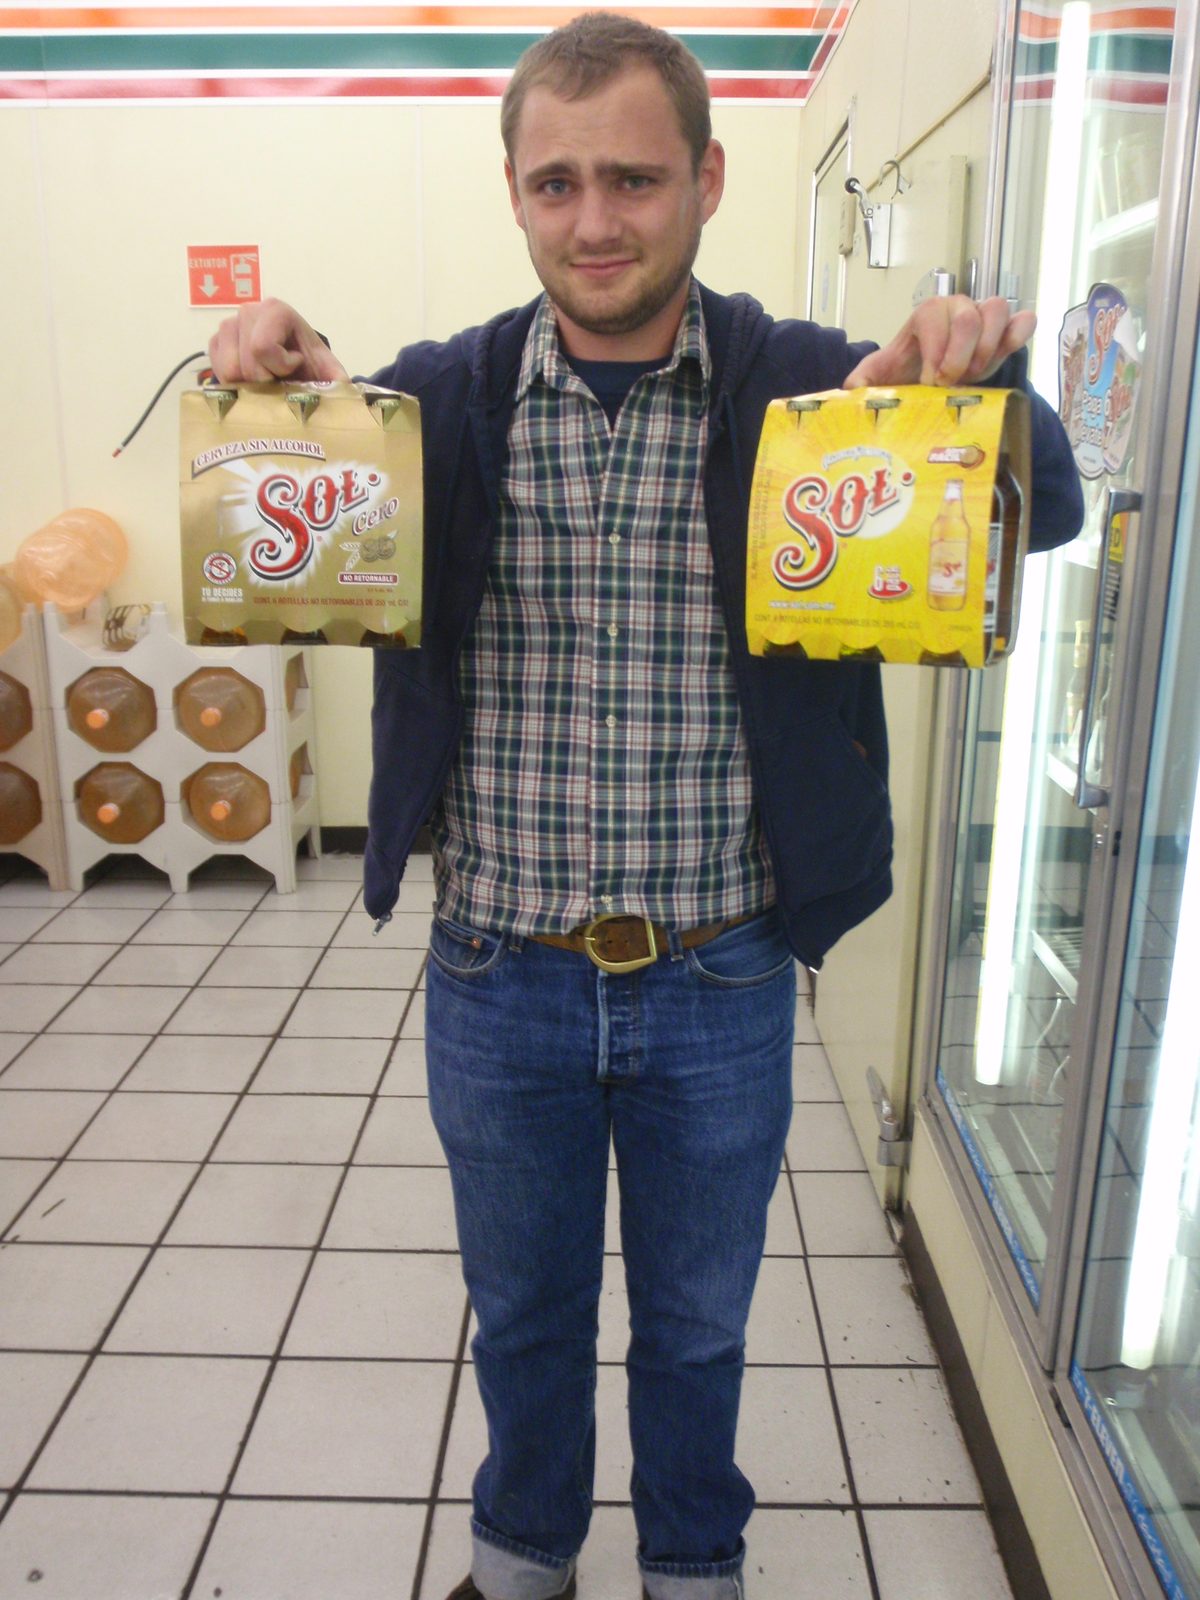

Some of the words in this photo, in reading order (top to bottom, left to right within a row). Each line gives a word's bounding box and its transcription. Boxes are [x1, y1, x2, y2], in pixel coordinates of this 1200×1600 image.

[196, 440, 247, 467] CERVEZA
[248, 439, 269, 451] SIN
[270, 439, 324, 457] ALCOHOL
[343, 574, 353, 582] NO
[354, 574, 393, 583] RETORNABLE
[202, 587, 211, 597] TU
[213, 587, 243, 598] DECIDES
